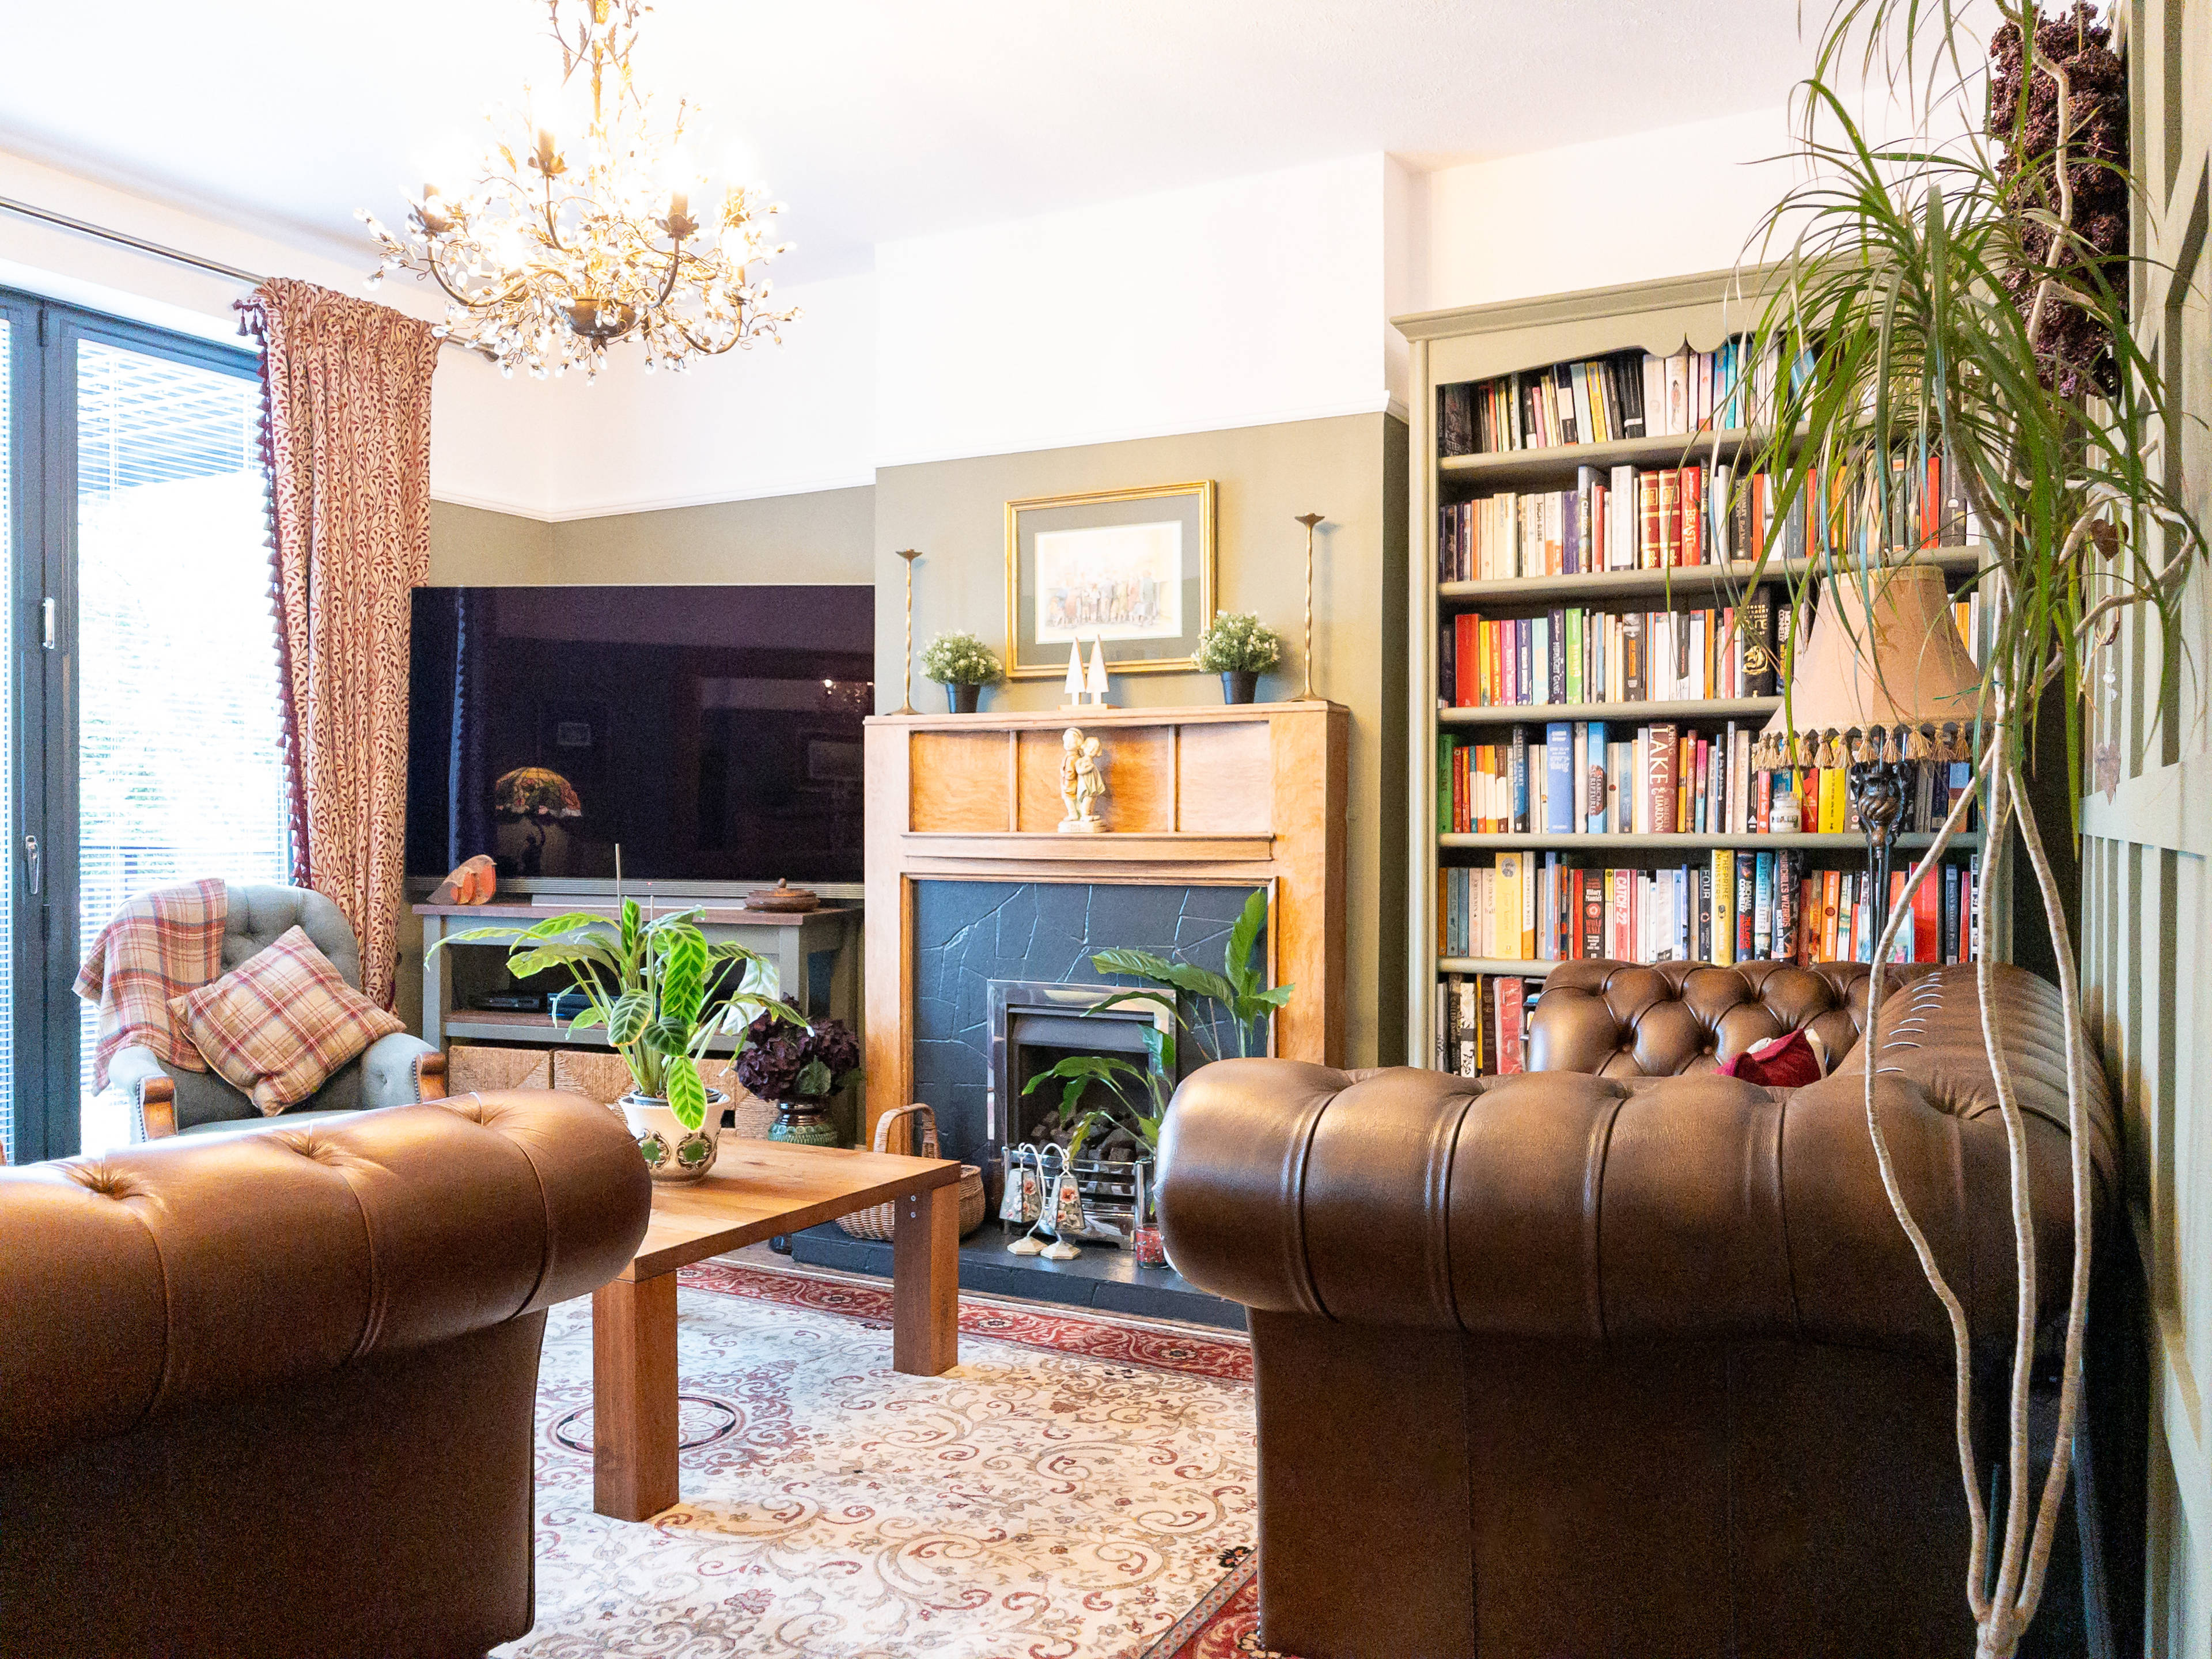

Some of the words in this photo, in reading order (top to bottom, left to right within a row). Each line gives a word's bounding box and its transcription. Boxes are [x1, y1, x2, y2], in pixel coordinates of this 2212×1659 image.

[1581, 500, 1589, 536] Clarkson
[1683, 509, 1696, 544] BEAST
[1668, 724, 1676, 747] JOHN
[1649, 726, 1669, 785] LAKE
[1654, 795, 1664, 832] LIARDON
[1702, 869, 1711, 899] FOUR
[1758, 857, 1767, 895] PRATCHETT
[1779, 849, 1789, 893] CHURCHILL'S
[1616, 876, 1627, 925] CATCH-22
[1758, 904, 1767, 930] BAXTER
[1781, 894, 1791, 927] WIZARDS
